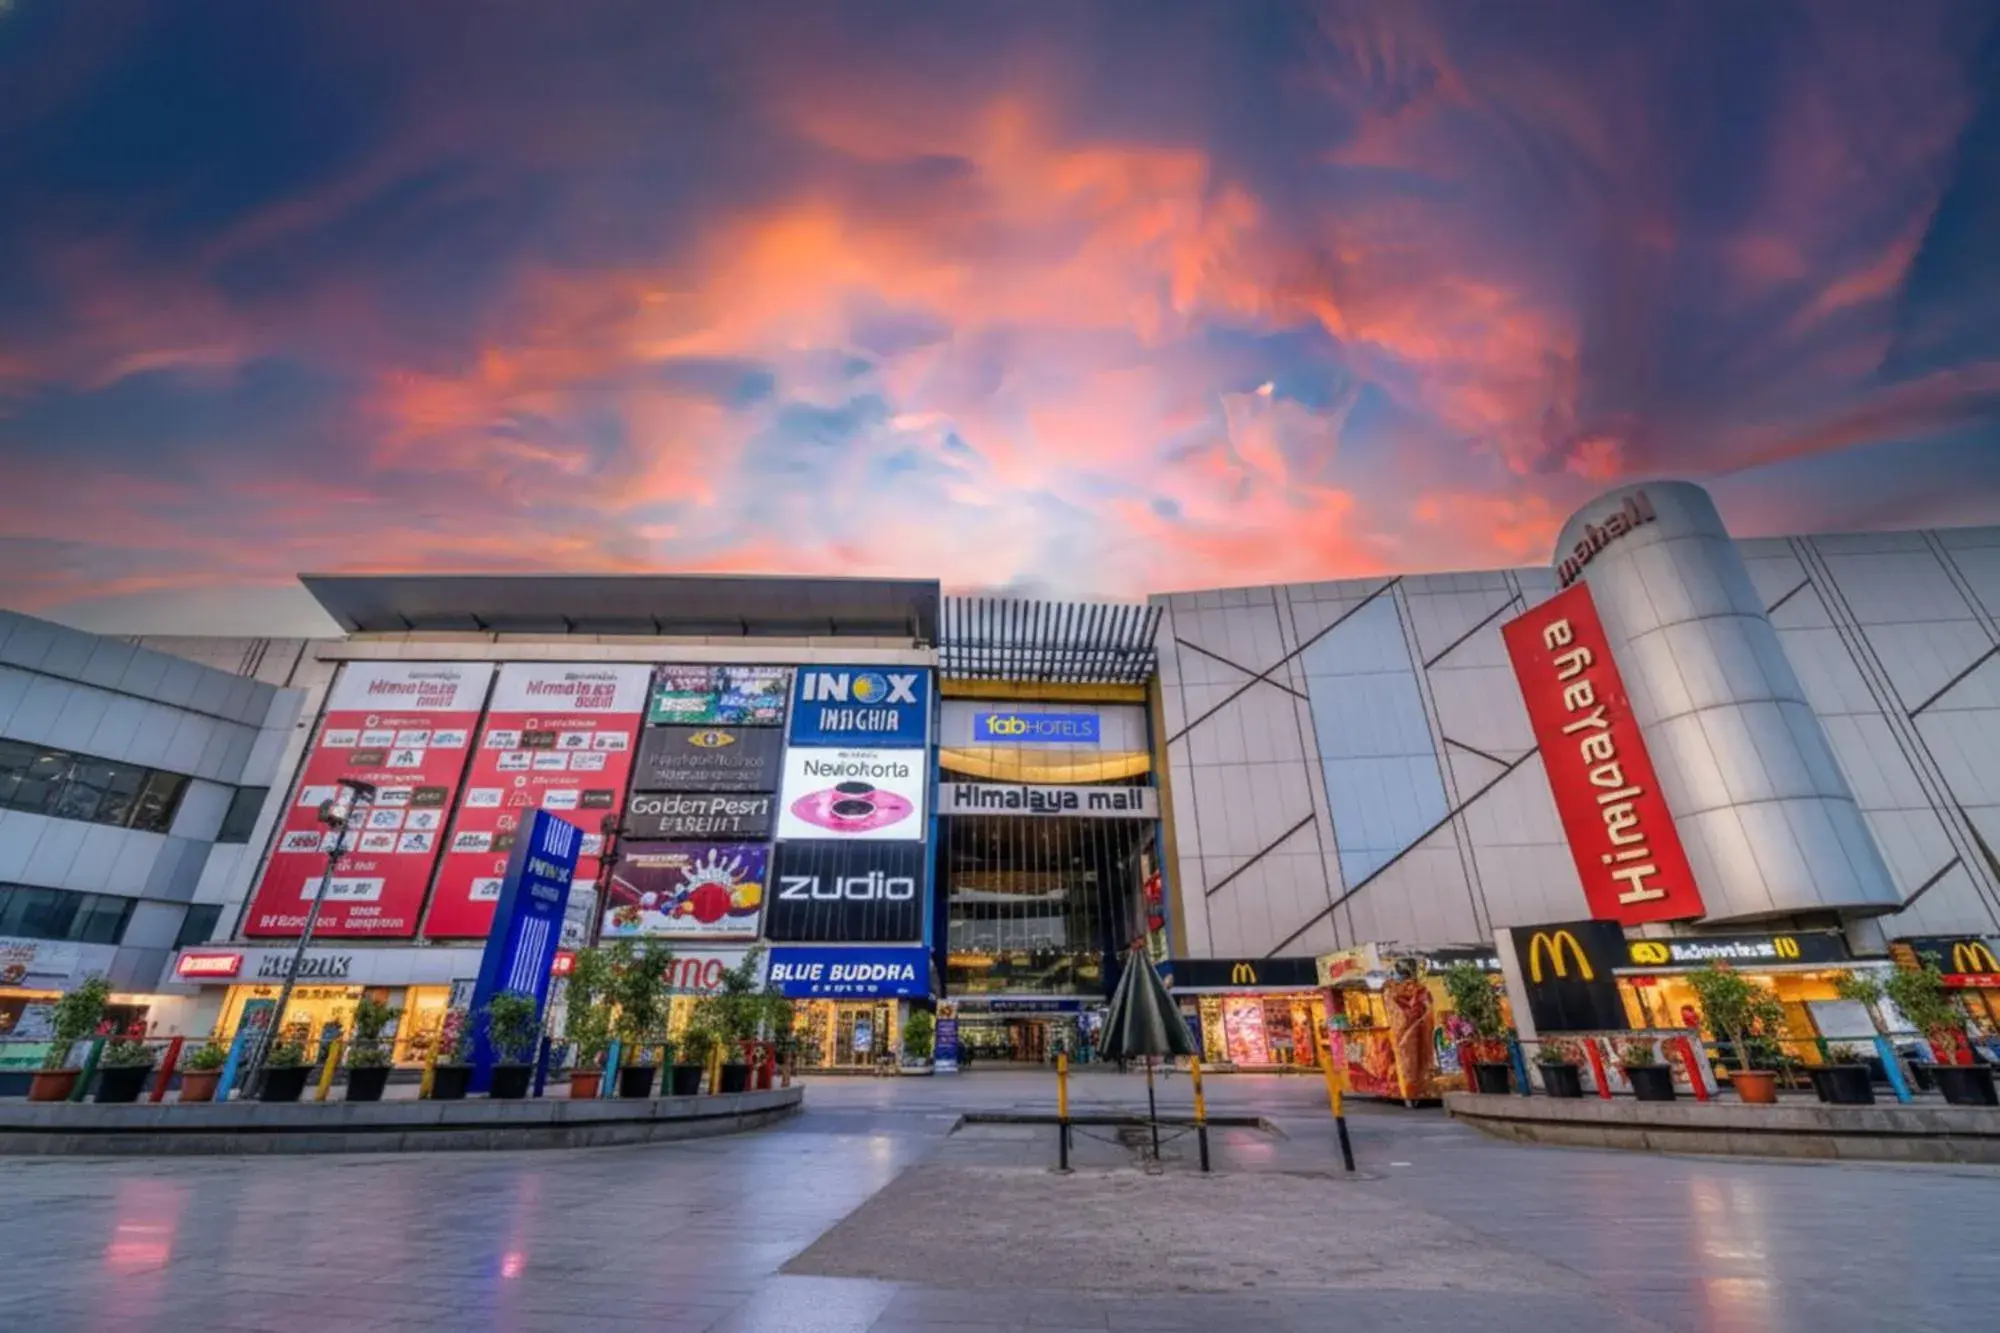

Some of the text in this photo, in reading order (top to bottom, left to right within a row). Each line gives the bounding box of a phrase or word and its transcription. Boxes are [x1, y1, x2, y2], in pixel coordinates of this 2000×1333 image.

[802, 673, 918, 704] INOX
[779, 871, 914, 900] zudio
[770, 963, 824, 981] BLUE
